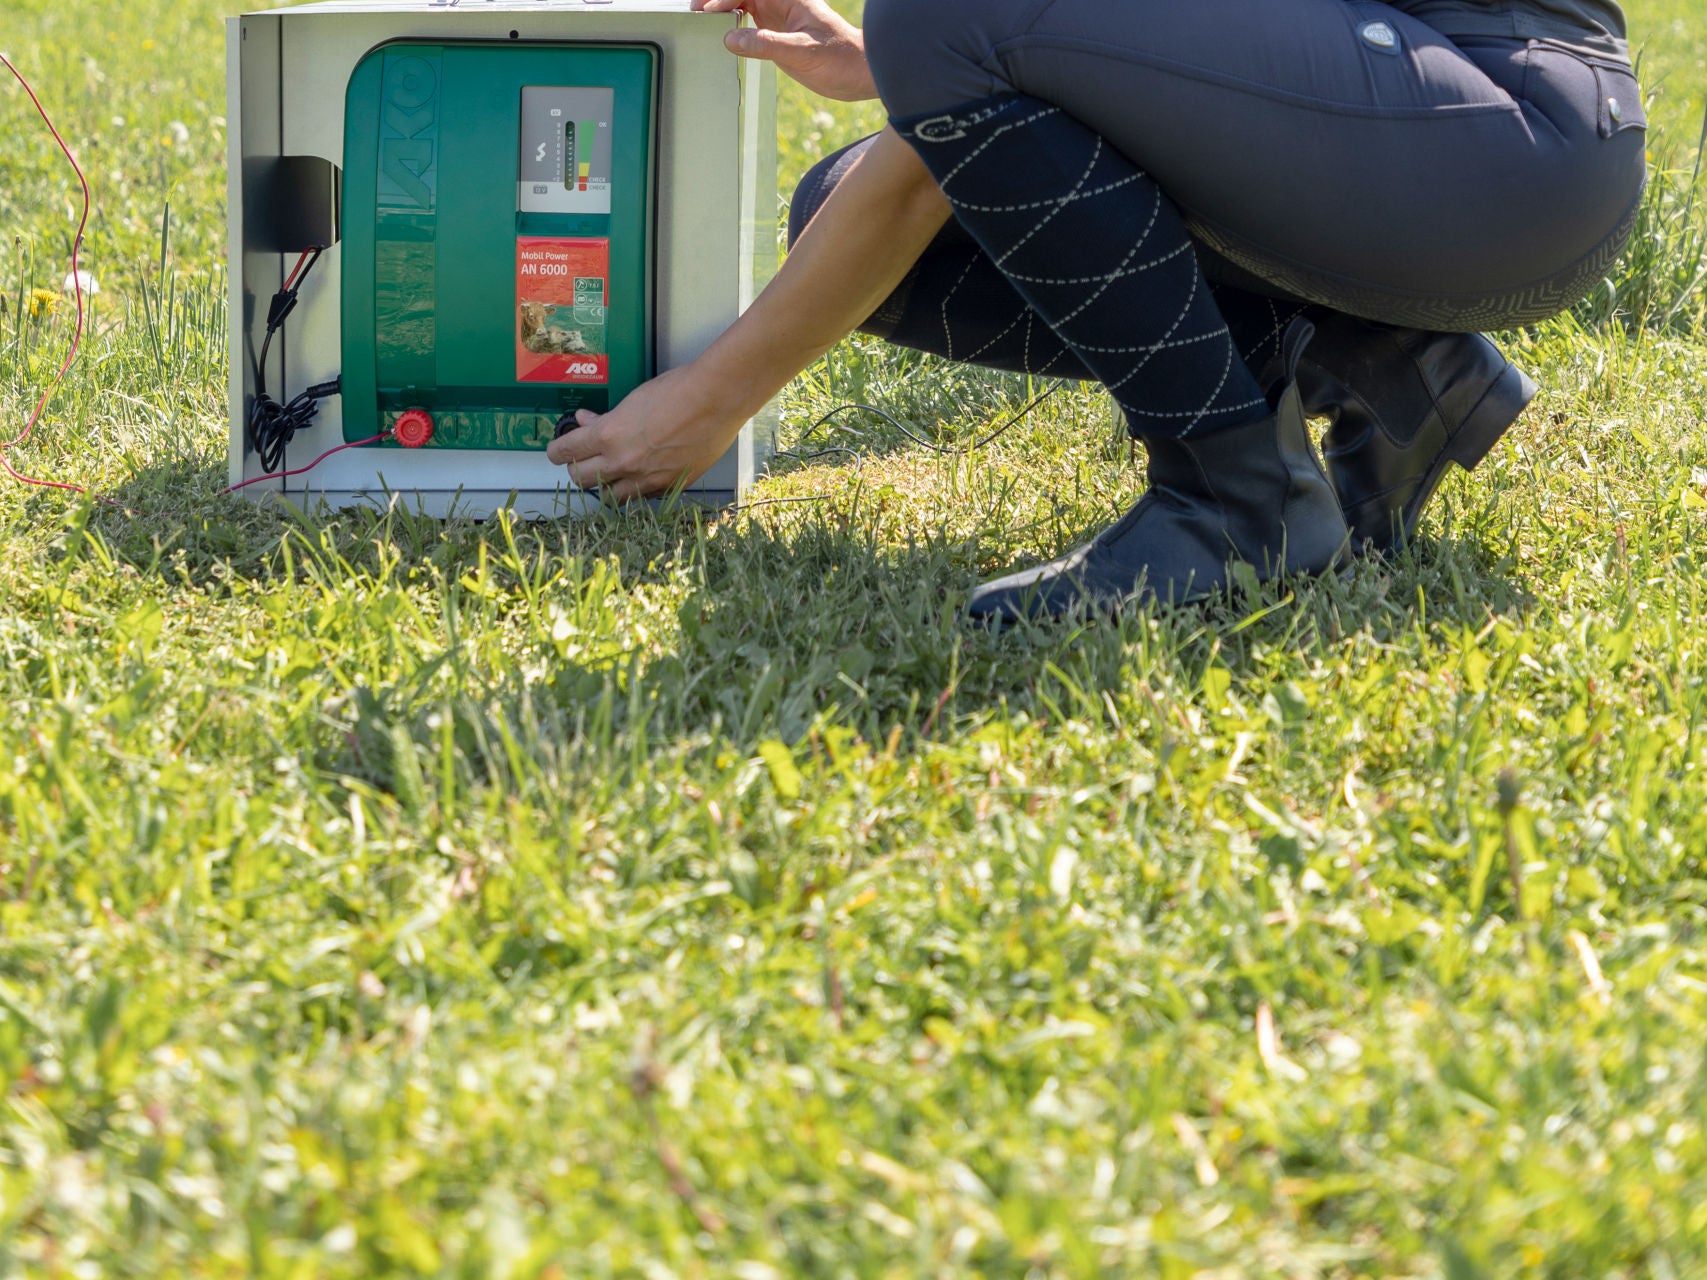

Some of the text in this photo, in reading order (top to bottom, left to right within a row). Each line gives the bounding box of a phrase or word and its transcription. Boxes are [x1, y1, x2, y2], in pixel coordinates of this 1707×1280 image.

[382, 55, 436, 210] AKO
[521, 251, 569, 261] Mobil Power
[521, 263, 568, 276] AN 6000
[566, 363, 598, 375] AKO
